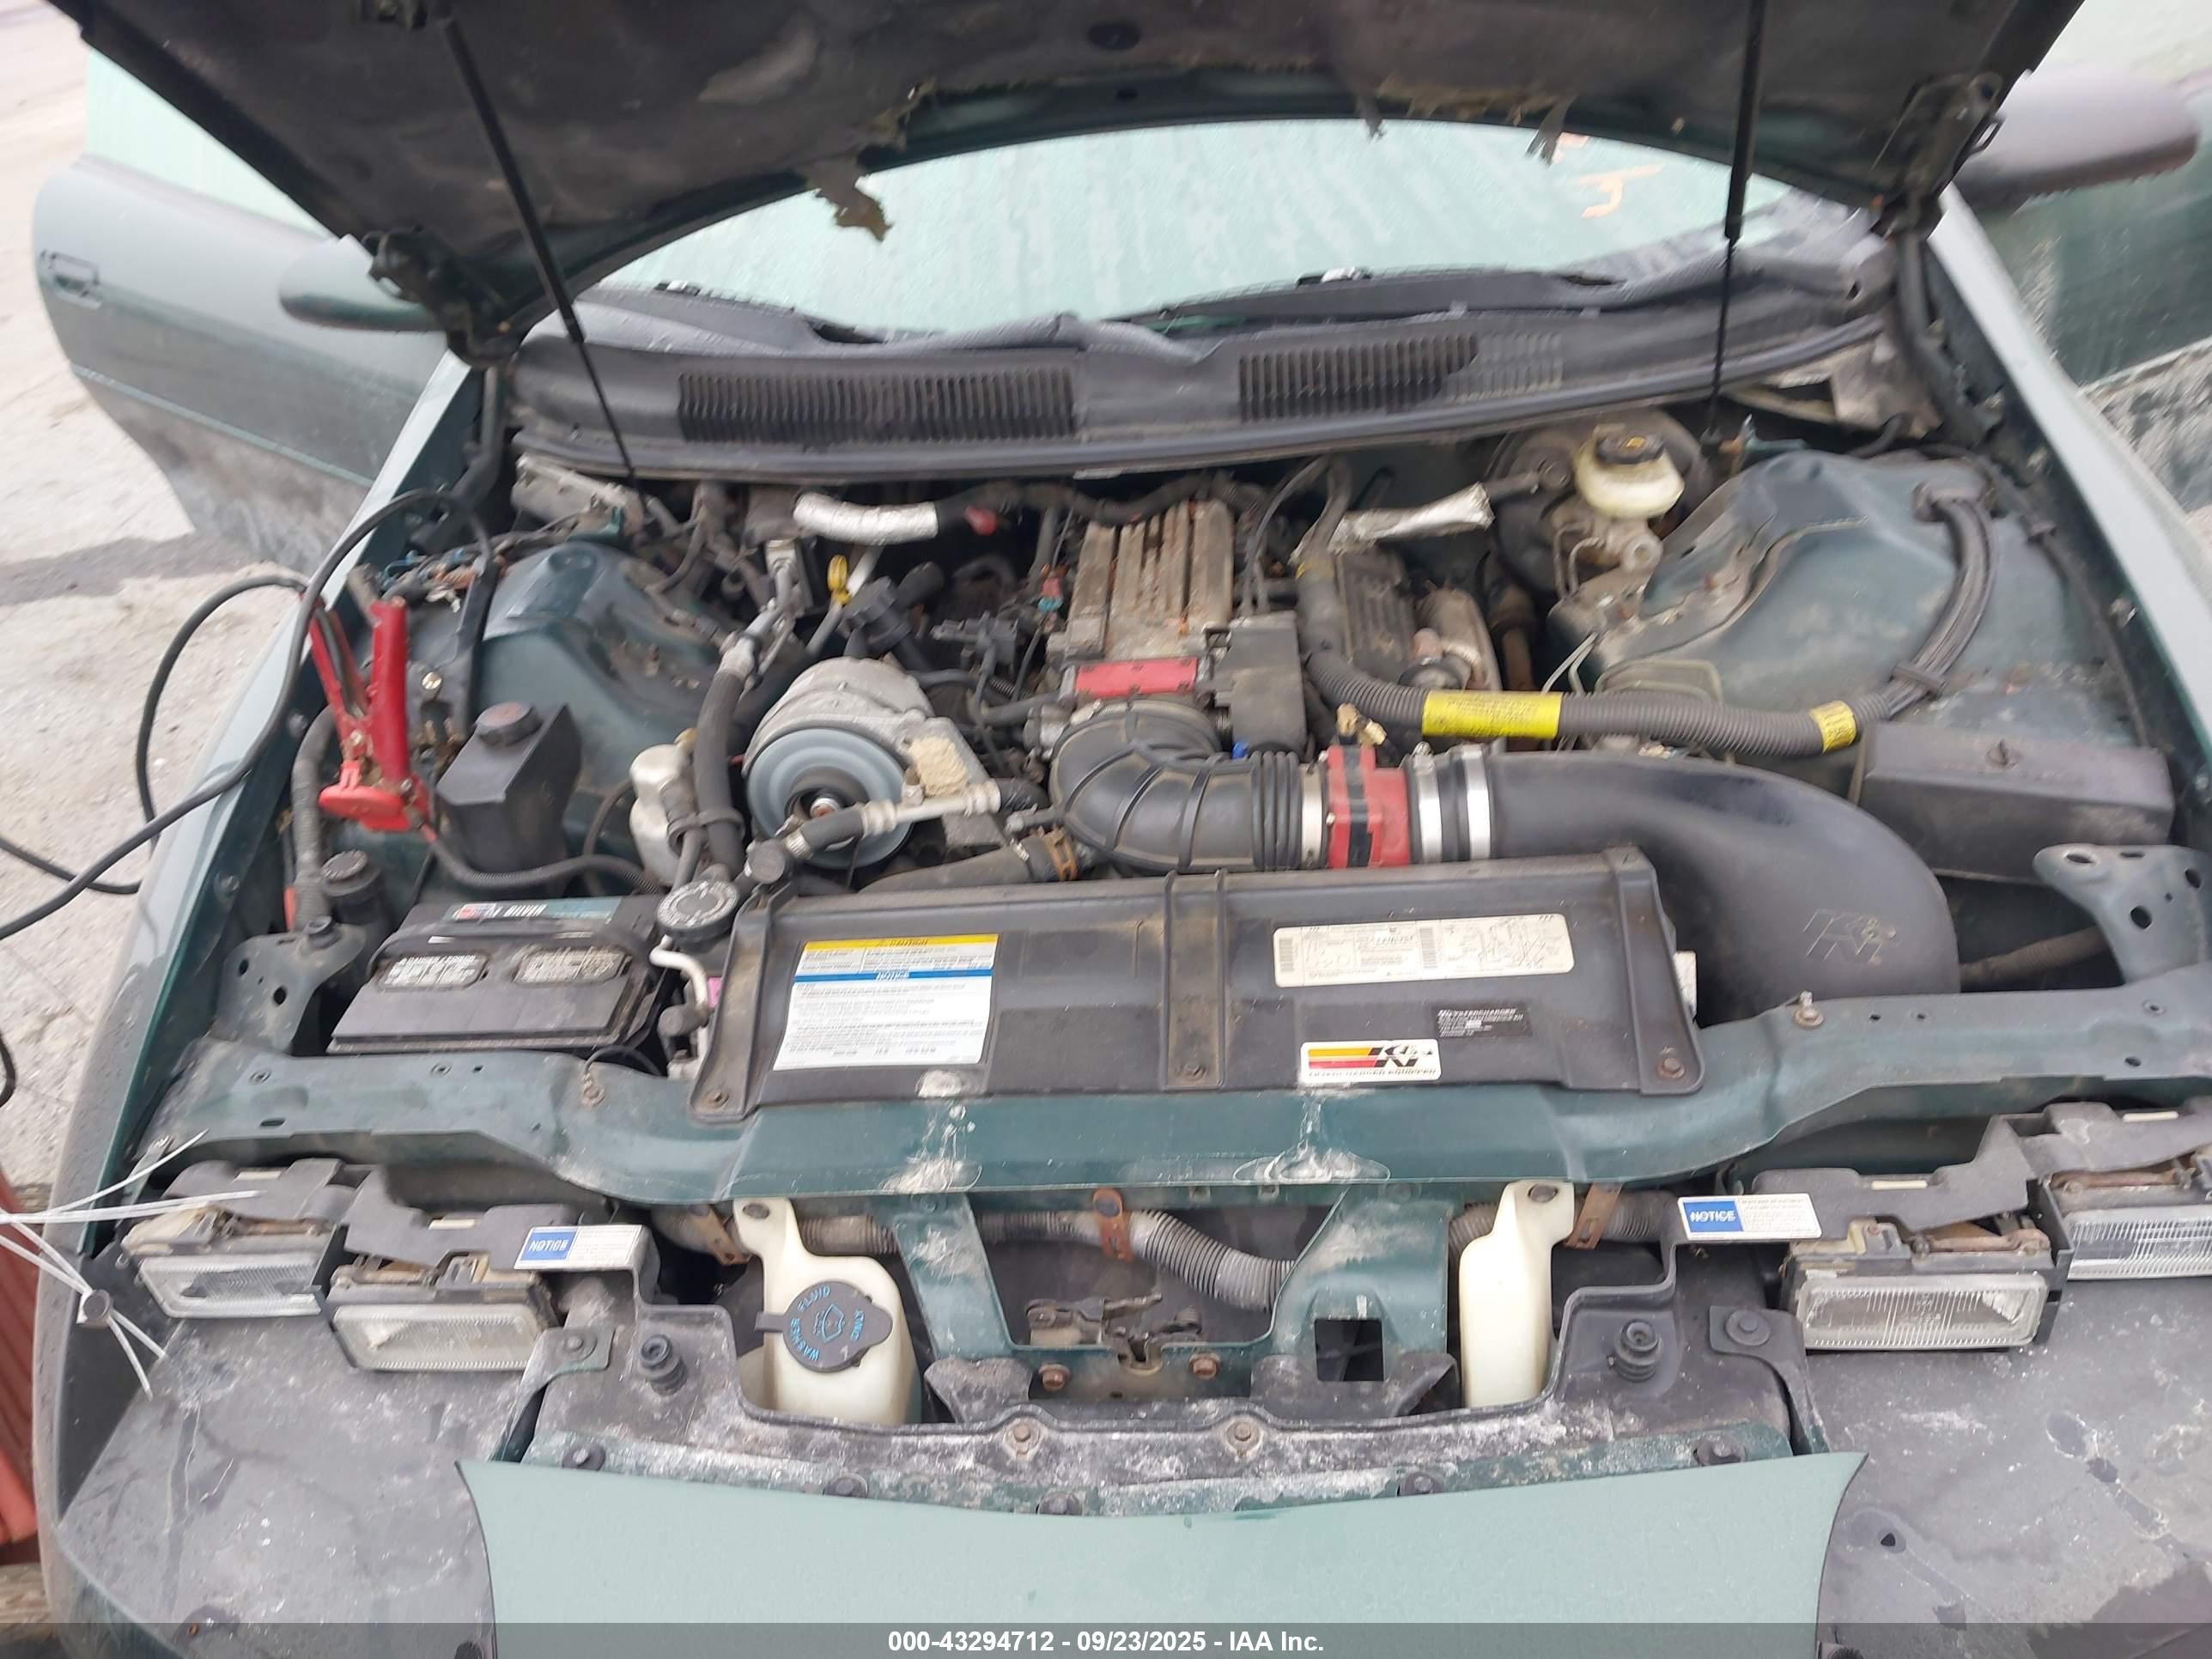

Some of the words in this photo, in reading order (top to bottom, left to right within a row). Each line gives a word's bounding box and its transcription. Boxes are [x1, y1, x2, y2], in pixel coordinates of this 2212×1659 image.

[1690, 1209, 1736, 1223] NOTICE
[528, 1239, 569, 1251] NOTICE
[797, 1285, 830, 1312] FLUID
[790, 1317, 820, 1361] WASHER
